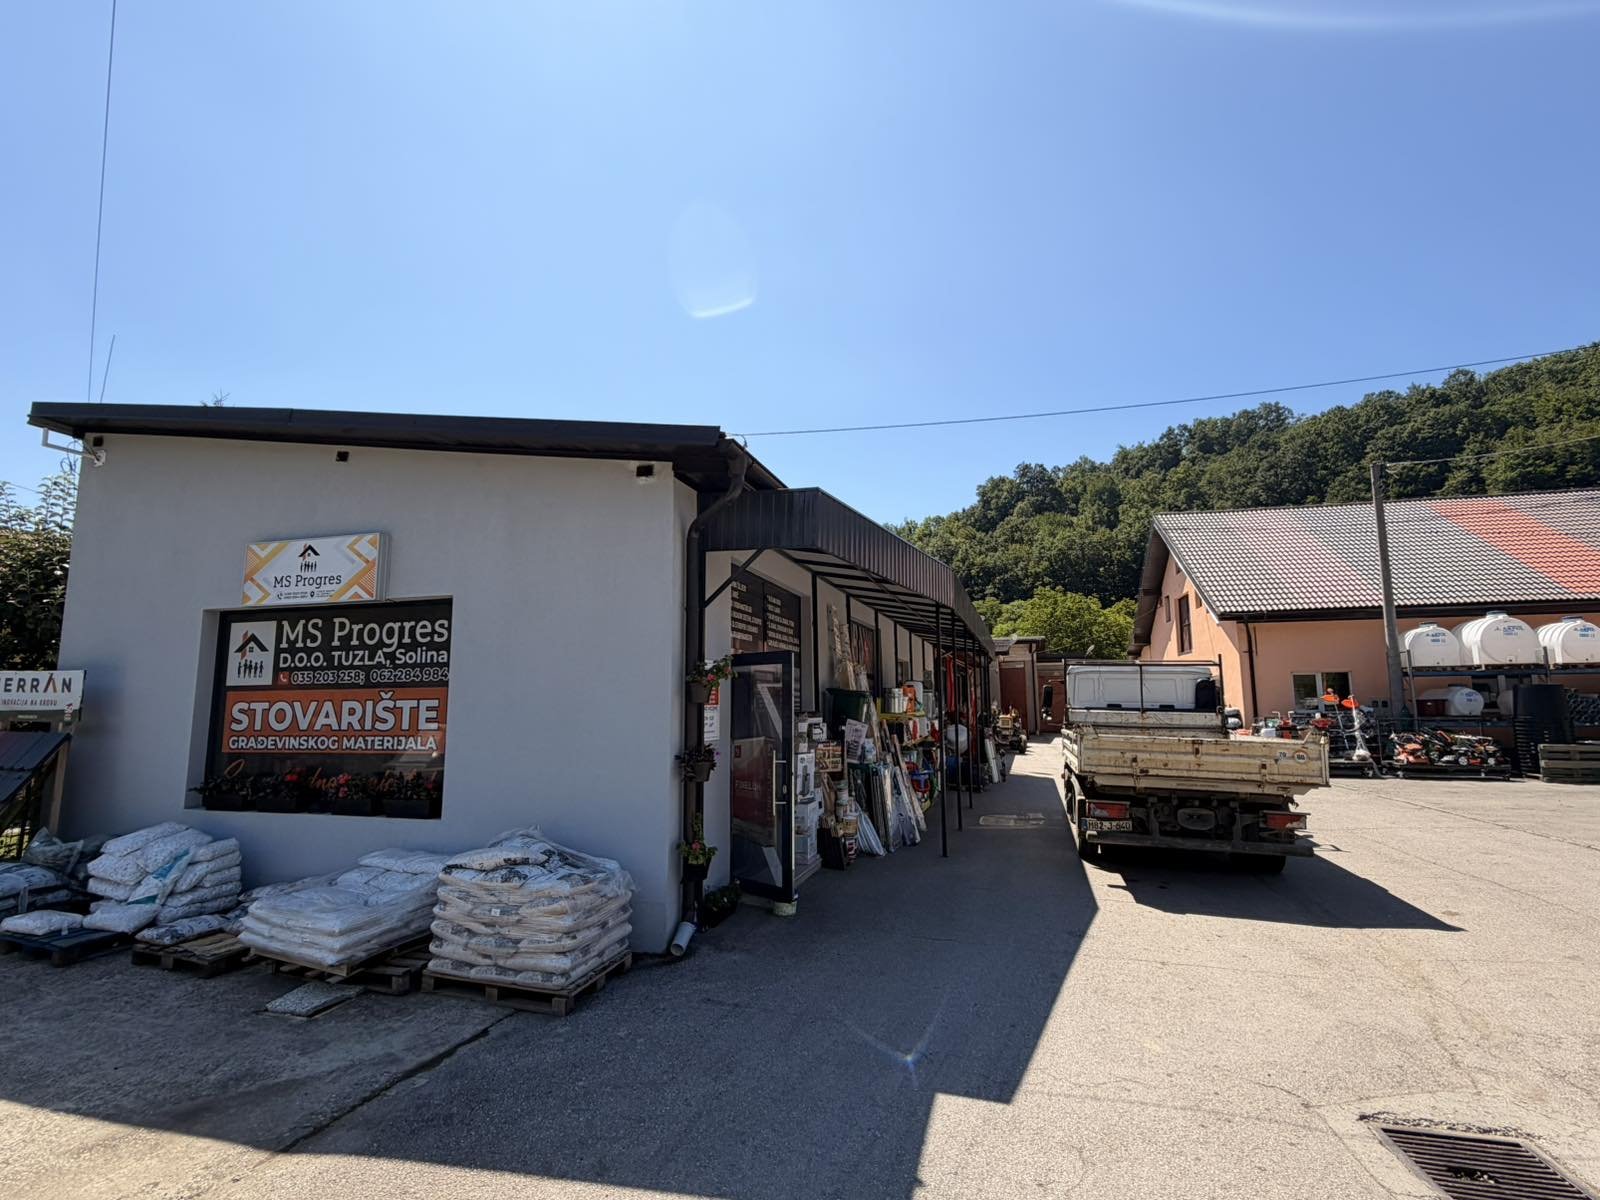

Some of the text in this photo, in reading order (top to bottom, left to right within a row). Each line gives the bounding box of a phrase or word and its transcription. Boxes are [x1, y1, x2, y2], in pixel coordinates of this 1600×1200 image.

[273, 574, 342, 589] MS Progres
[279, 617, 449, 652] MS Progres
[279, 646, 448, 668] D.O.O. TUZLA, Solina
[291, 667, 449, 685] 035 203 258; 062 284 984
[229, 691, 440, 732] STOVARIŠTE
[228, 735, 437, 750] GRAĐEVINSKOG MATERIJALA
